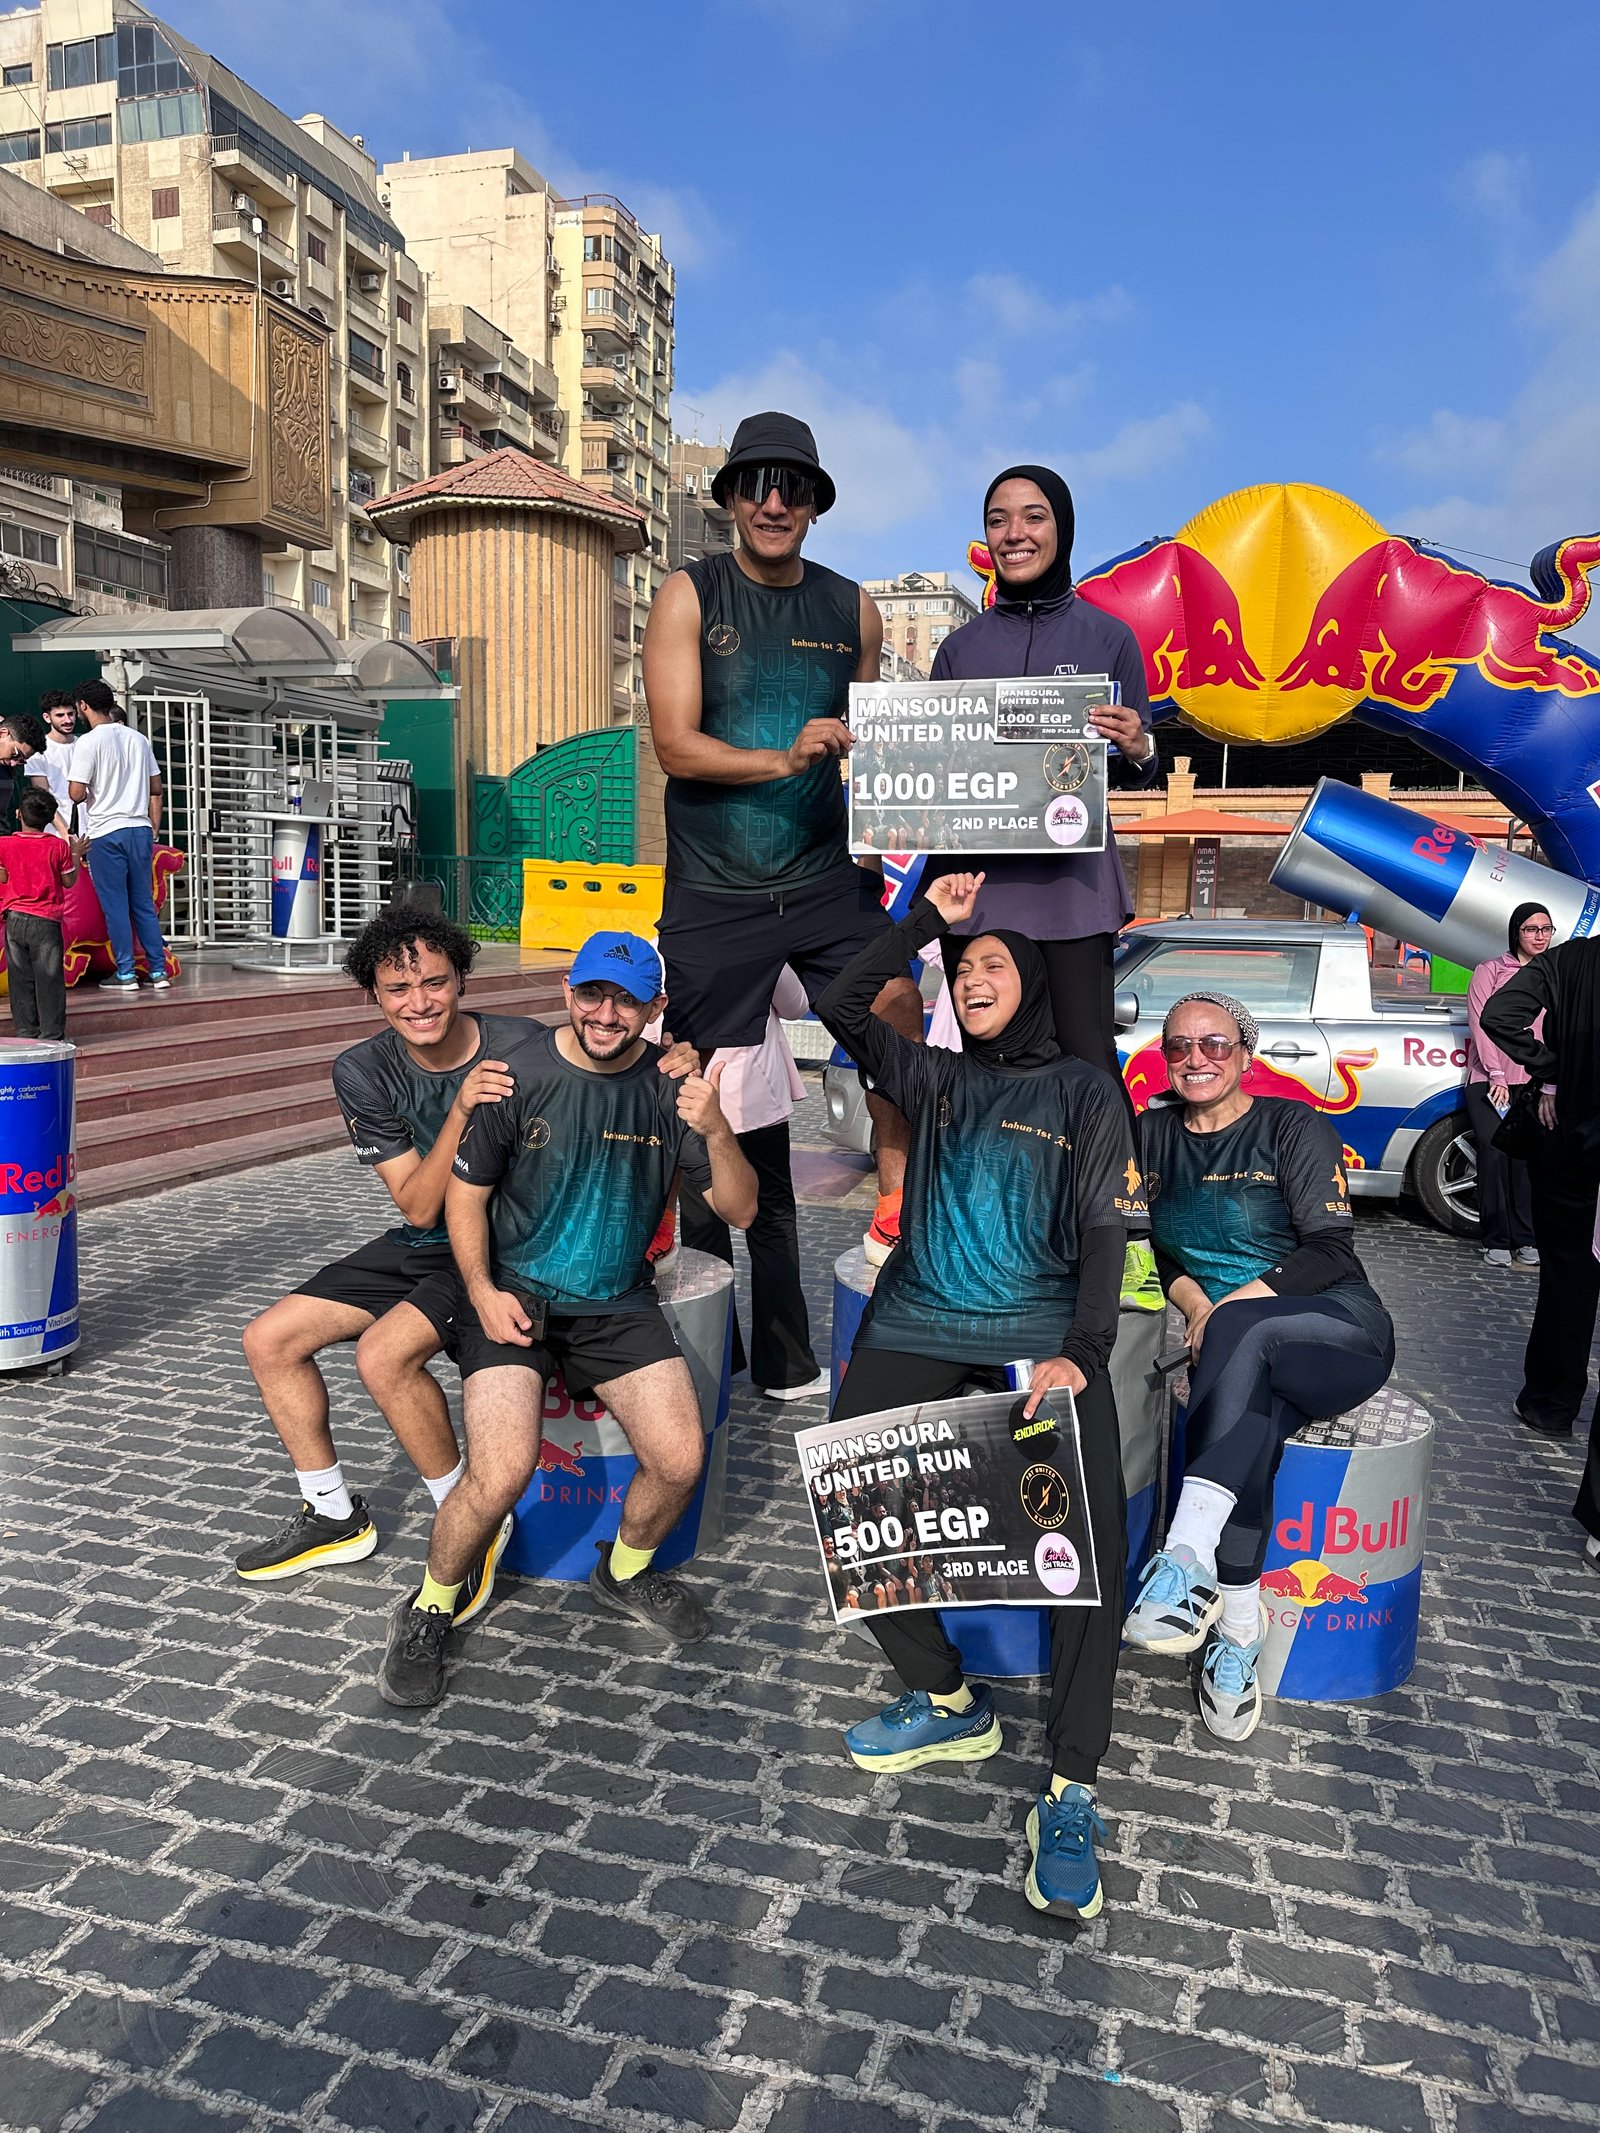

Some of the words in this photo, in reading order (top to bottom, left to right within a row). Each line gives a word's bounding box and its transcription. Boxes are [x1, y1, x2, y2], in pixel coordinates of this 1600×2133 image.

[836, 642, 853, 653] Run
[1000, 689, 1060, 697] MANSOURA
[857, 697, 989, 717] MANSOURA
[998, 714, 1035, 724] 1000
[1040, 714, 1072, 724] EGP
[857, 724, 944, 742] UNITED
[951, 723, 998, 742] RUN
[854, 772, 936, 801] 1000
[947, 771, 1018, 800] EGP
[952, 817, 984, 830] 2ND
[988, 816, 1039, 830] PLACE
[1411, 824, 1457, 866] Re
[1199, 887, 1209, 905] 1
[603, 952, 634, 966] adidas
[1403, 1037, 1471, 1068] Red
[0, 1154, 62, 1195] Red
[1251, 1170, 1276, 1182] Run
[0, 1326, 10, 1338] ith
[1013, 1418, 1057, 1441] ENDUROX
[805, 1419, 956, 1470] MANSOURA
[813, 1457, 910, 1497] UNITED
[917, 1447, 972, 1475] RUN
[1034, 1467, 1056, 1479] UNITED
[540, 1484, 624, 1504] DRINK
[834, 1516, 905, 1559] 500
[914, 1505, 990, 1543] EGP
[1323, 1496, 1410, 1555] Bull
[1042, 1546, 1068, 1562] Girls
[943, 1561, 973, 1579] 3RD
[978, 1559, 1030, 1577] PLACE
[1042, 1561, 1053, 1570] ON
[1267, 1608, 1316, 1631] RGY
[1326, 1608, 1394, 1632] DRINK
